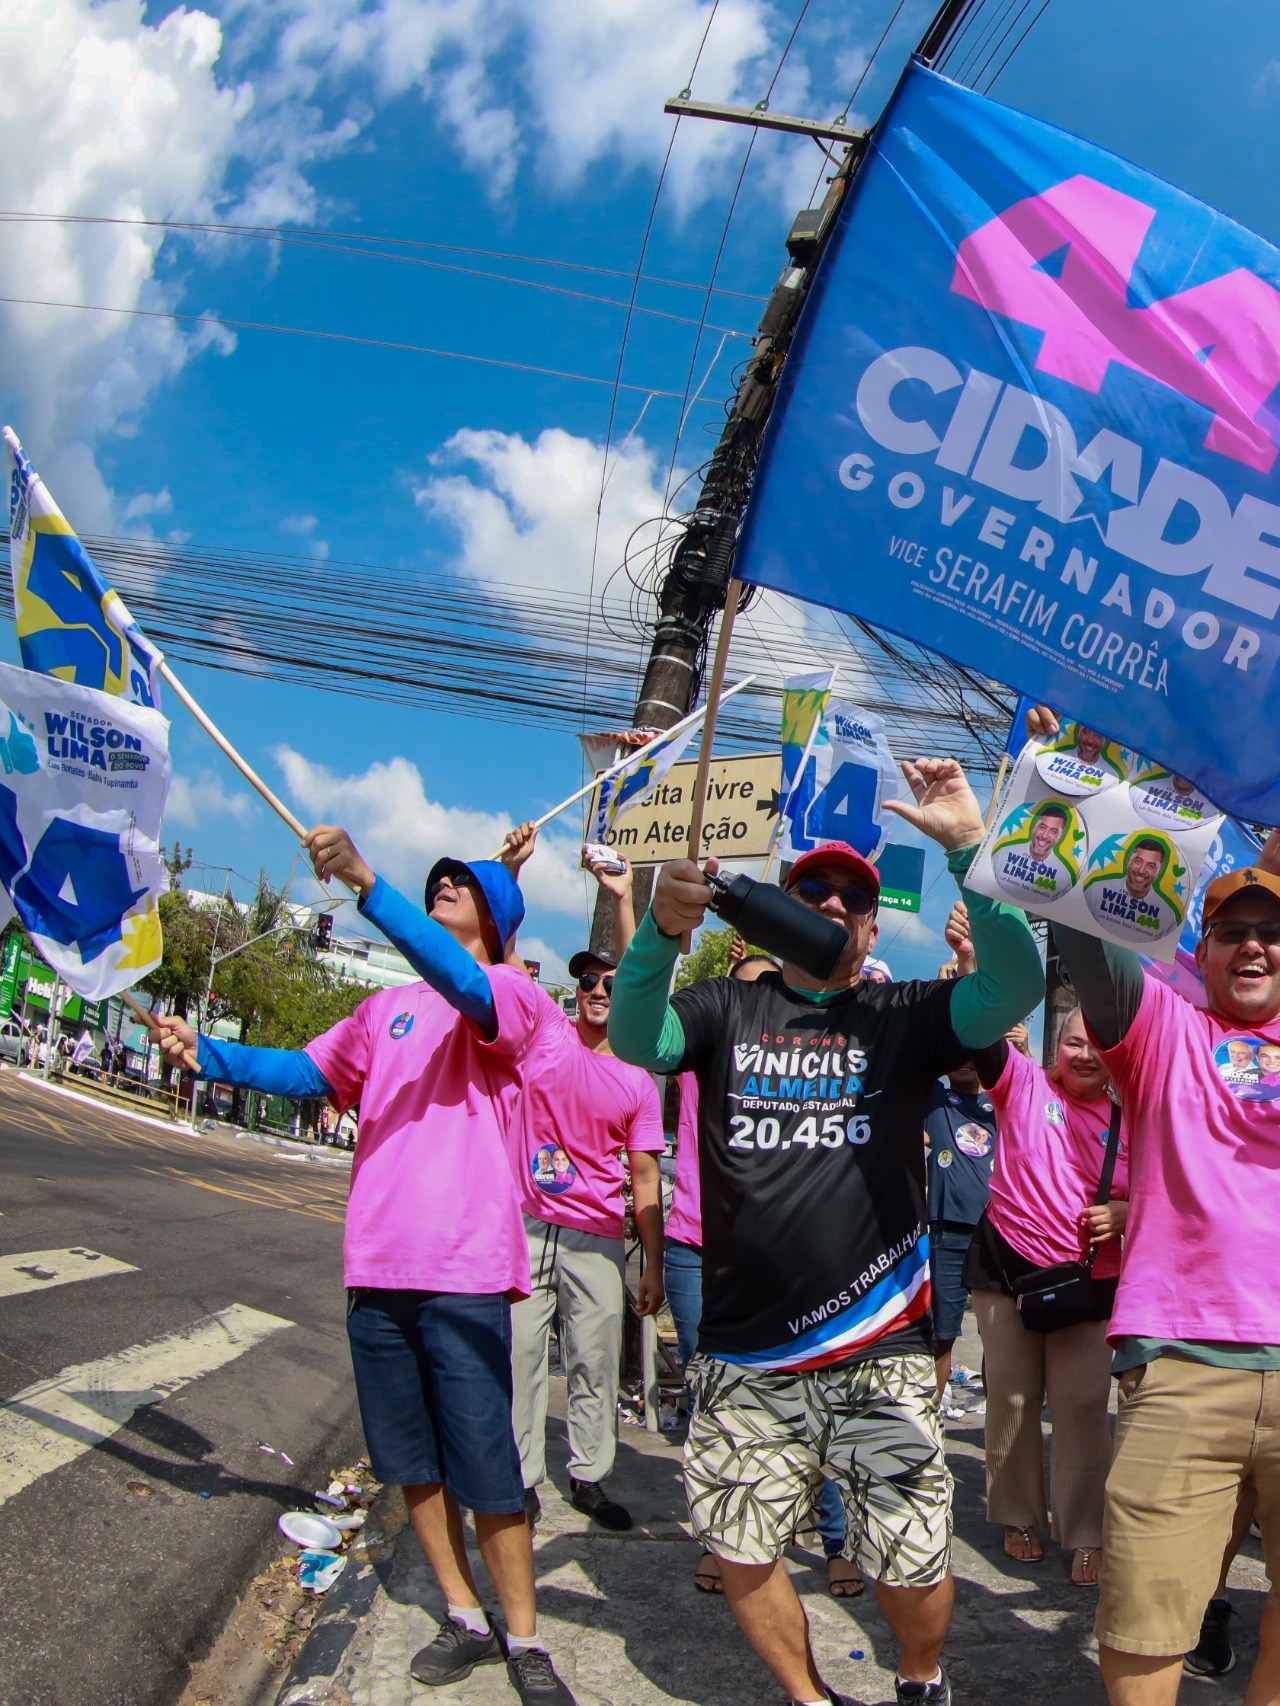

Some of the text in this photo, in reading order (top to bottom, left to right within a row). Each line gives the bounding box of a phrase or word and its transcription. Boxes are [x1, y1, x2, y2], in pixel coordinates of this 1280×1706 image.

[838, 454, 1262, 671] GOVERNADOR
[888, 535, 1170, 697] VICE SERAFIM CORRÊA
[70, 710, 113, 727] SENADOR
[835, 714, 873, 739] WILSON
[44, 712, 142, 752] WILSON
[836, 725, 862, 742] LIMA
[47, 736, 107, 771] LIMA
[117, 753, 148, 762] SENADOR
[125, 762, 144, 770] POVO
[61, 763, 86, 778] Bonates
[103, 776, 139, 789] Tupinambá
[1047, 765, 1104, 787] LIMA 444
[1053, 756, 1106, 779] WILSON
[641, 783, 683, 807] eita
[1142, 794, 1203, 820] LIMA 444
[1148, 786, 1205, 812] WILSON
[606, 827, 638, 847] om
[1003, 864, 1057, 891] LIMA 444
[1007, 852, 1057, 879] WILSON
[878, 895, 912, 906] raça 14
[1102, 887, 1160, 918] WILSON
[1100, 902, 1160, 930] LIMA 444
[761, 1033, 848, 1047] CORONE
[733, 1042, 868, 1079] VINÍCIUS
[741, 1075, 865, 1100] ALMEIDA
[742, 1098, 856, 1113] DEPUTADO ESTADUAL
[728, 1114, 872, 1151] 20.456
[787, 1290, 852, 1336] VAMOS
